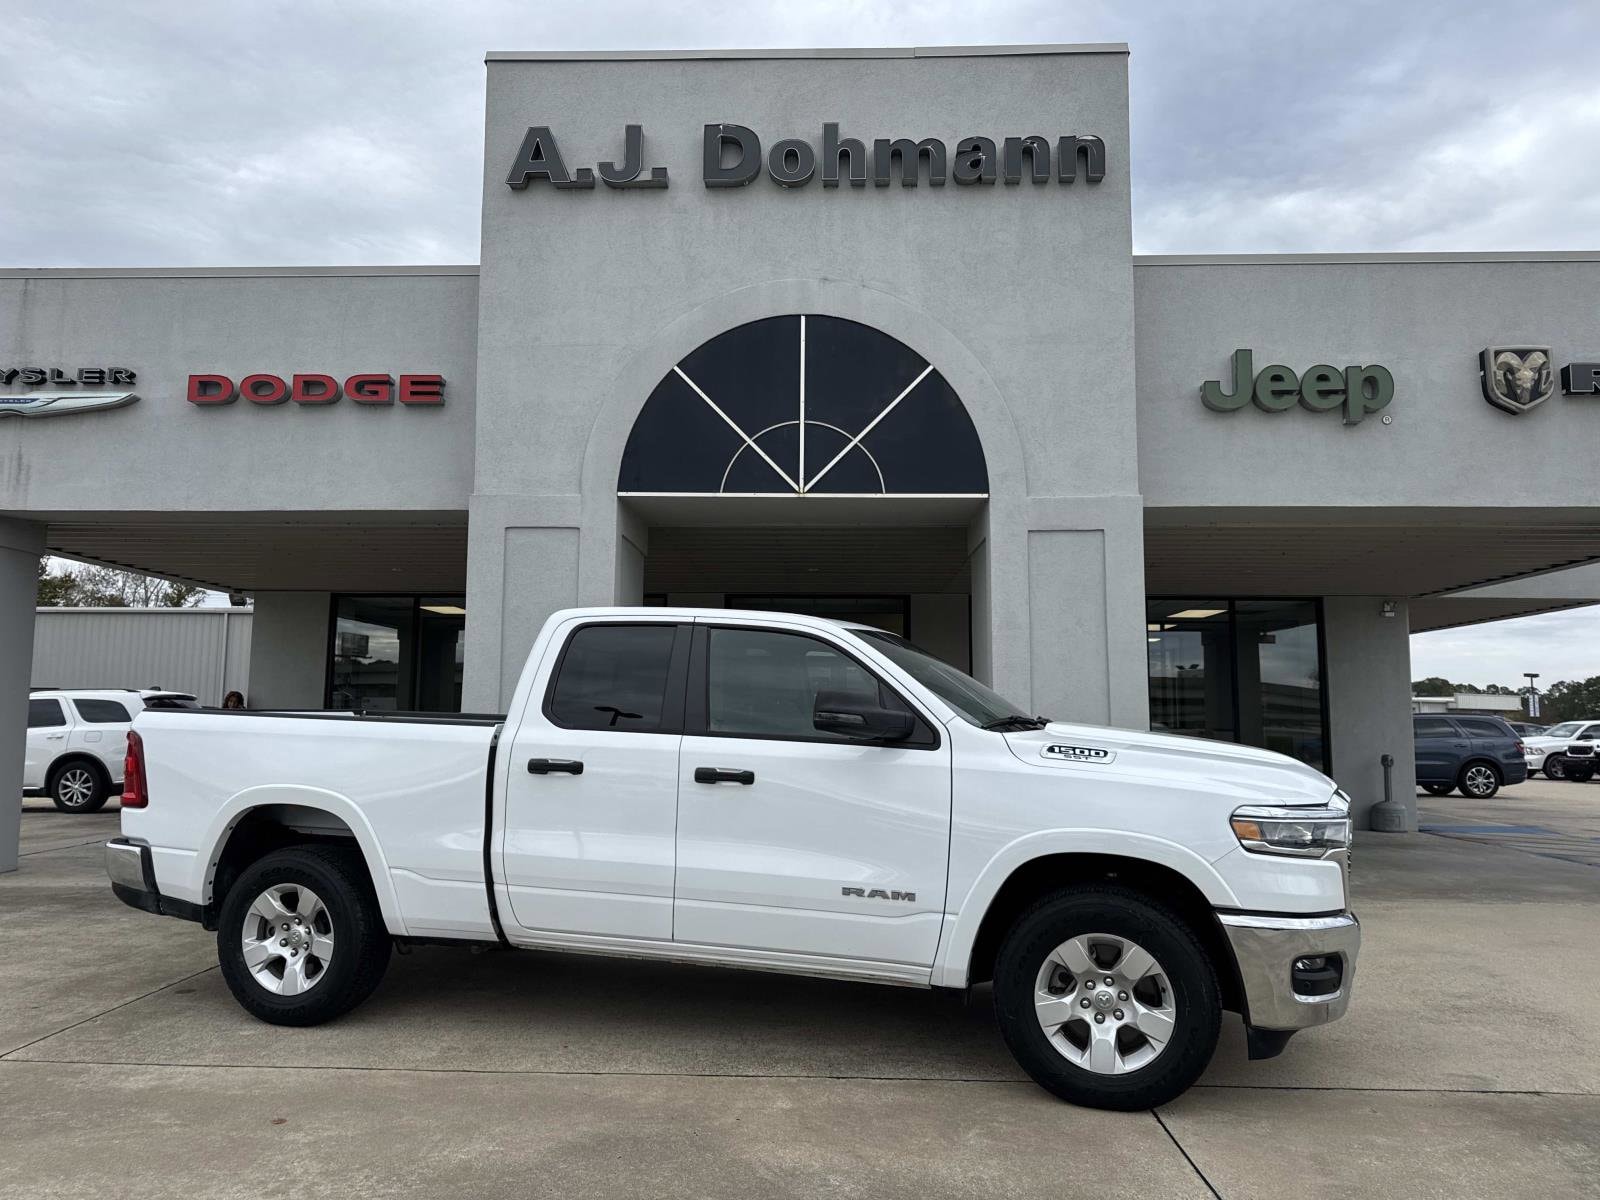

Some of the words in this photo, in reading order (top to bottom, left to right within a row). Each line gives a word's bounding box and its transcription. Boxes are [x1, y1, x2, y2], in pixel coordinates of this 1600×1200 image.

[504, 124, 668, 190] A.J.
[702, 122, 1107, 189] Dohmann
[186, 373, 446, 406] DODGE
[1200, 348, 1395, 425] Jeep
[1052, 746, 1105, 757] 1500
[841, 887, 916, 902] RAM
